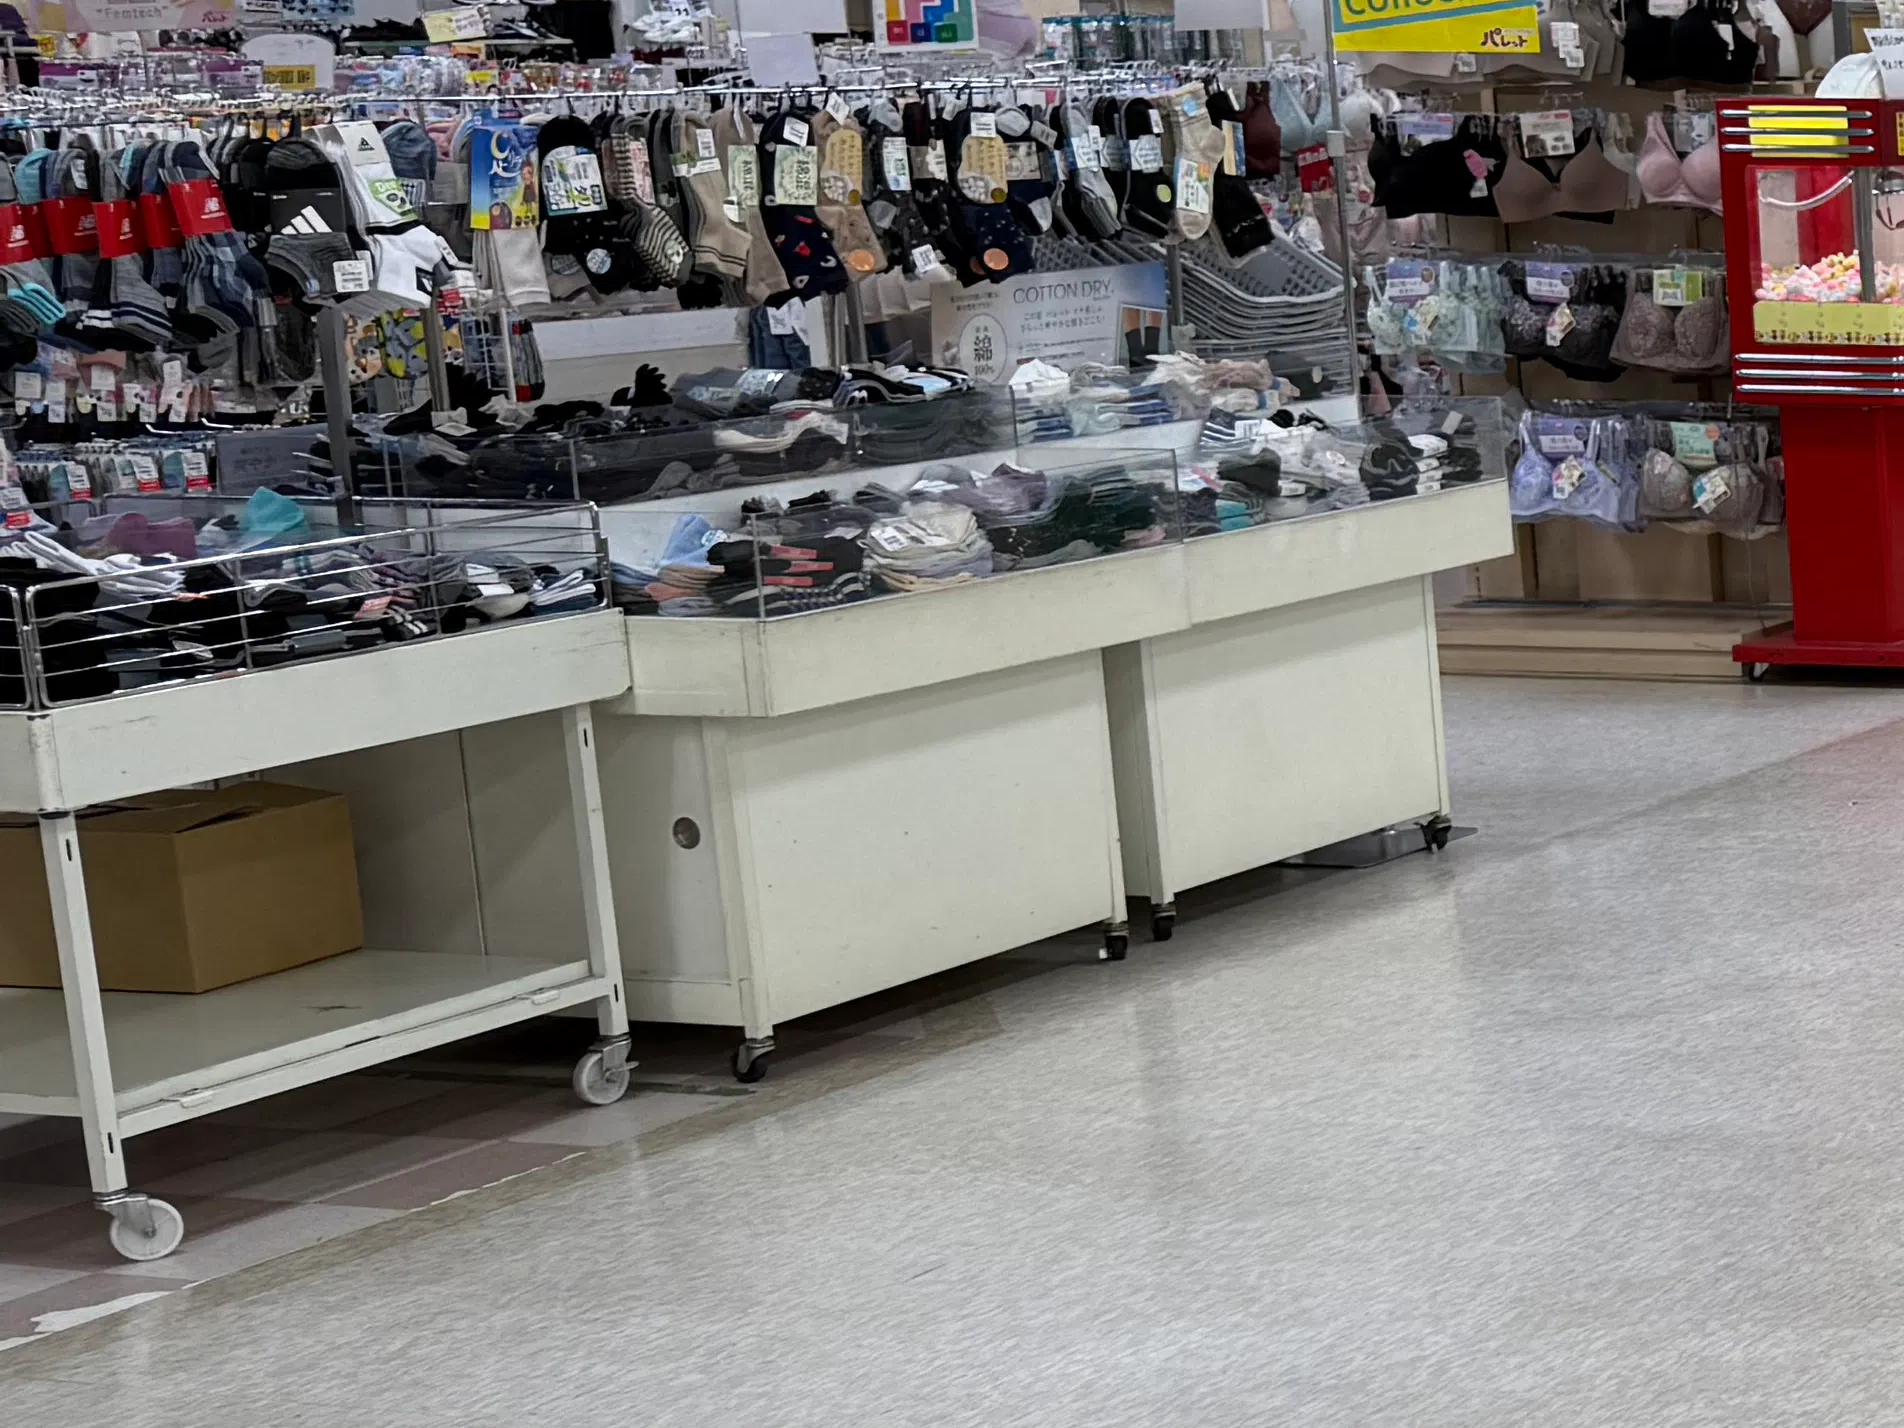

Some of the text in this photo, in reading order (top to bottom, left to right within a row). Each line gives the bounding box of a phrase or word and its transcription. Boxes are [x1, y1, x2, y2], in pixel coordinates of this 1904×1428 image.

[1480, 27, 1528, 48] パレット
[1013, 283, 1079, 305] COTTON
